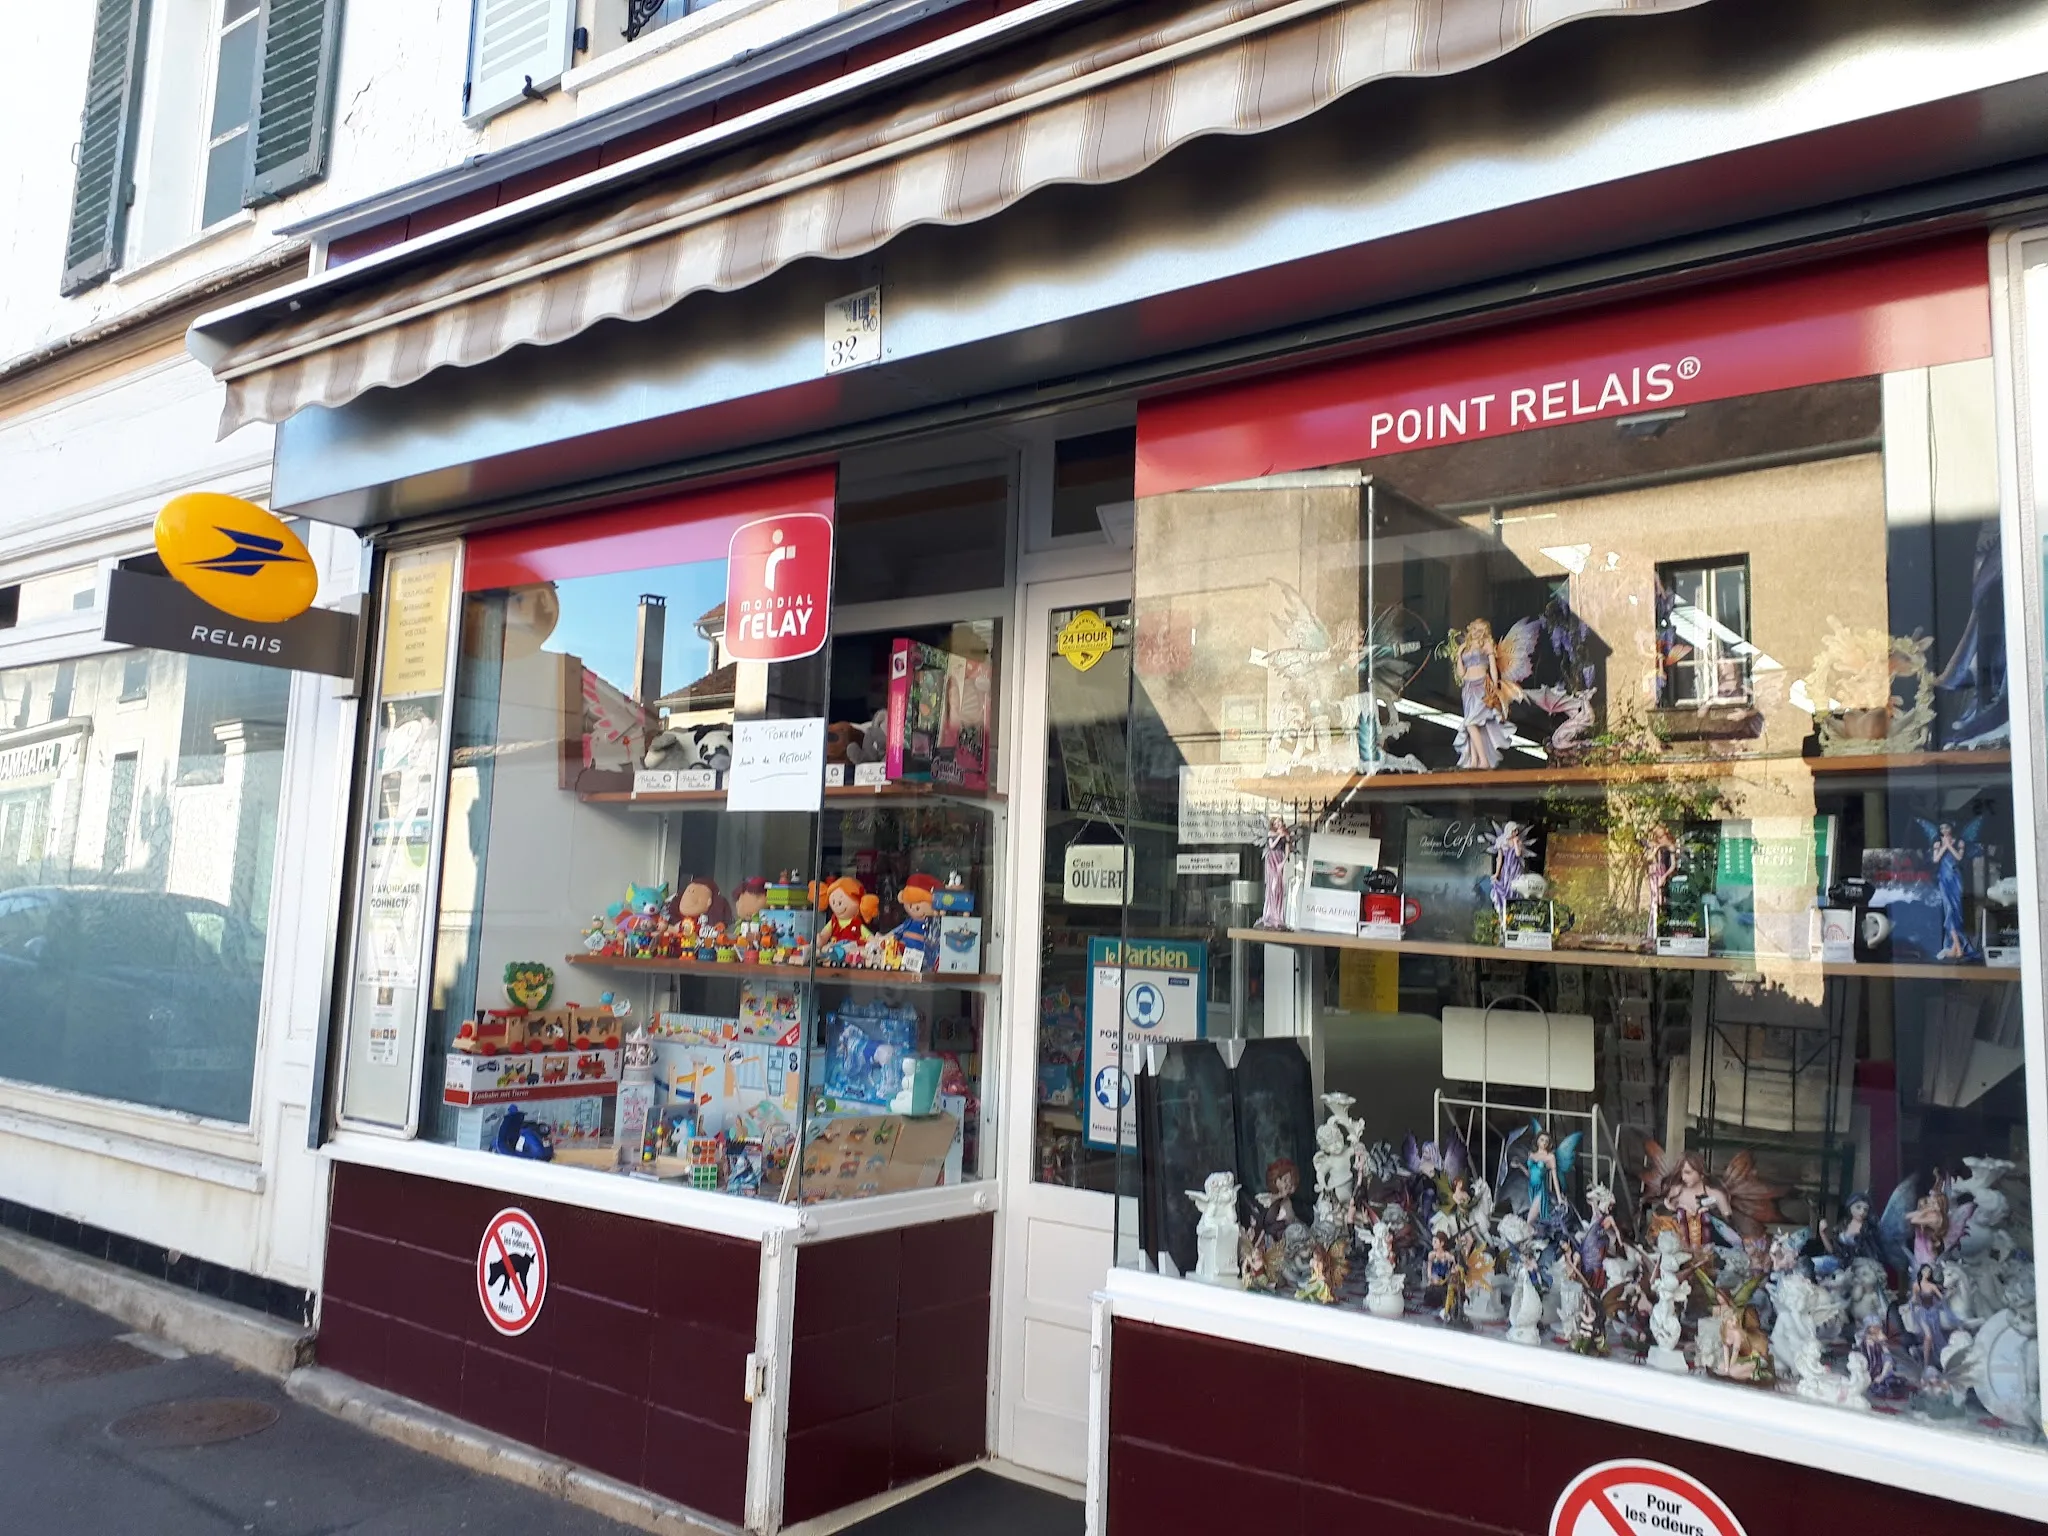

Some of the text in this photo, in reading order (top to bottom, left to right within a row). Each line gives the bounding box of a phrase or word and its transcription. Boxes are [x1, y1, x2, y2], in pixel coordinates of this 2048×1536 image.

[831, 335, 858, 367] 32
[1370, 394, 1496, 449] POINT
[190, 625, 282, 653] RELAIS
[1062, 631, 1107, 645] 24 HOUR
[1072, 858, 1094, 868] C'est
[1072, 869, 1124, 889] OUVERT
[1105, 940, 1188, 969] le Parisien
[1100, 1029, 1120, 1040] POR
[1127, 1032, 1141, 1041] DU
[504, 1235, 513, 1246] les
[511, 1226, 523, 1238] Pour
[1625, 1504, 1647, 1525] les
[1647, 1493, 1682, 1517] Pour
